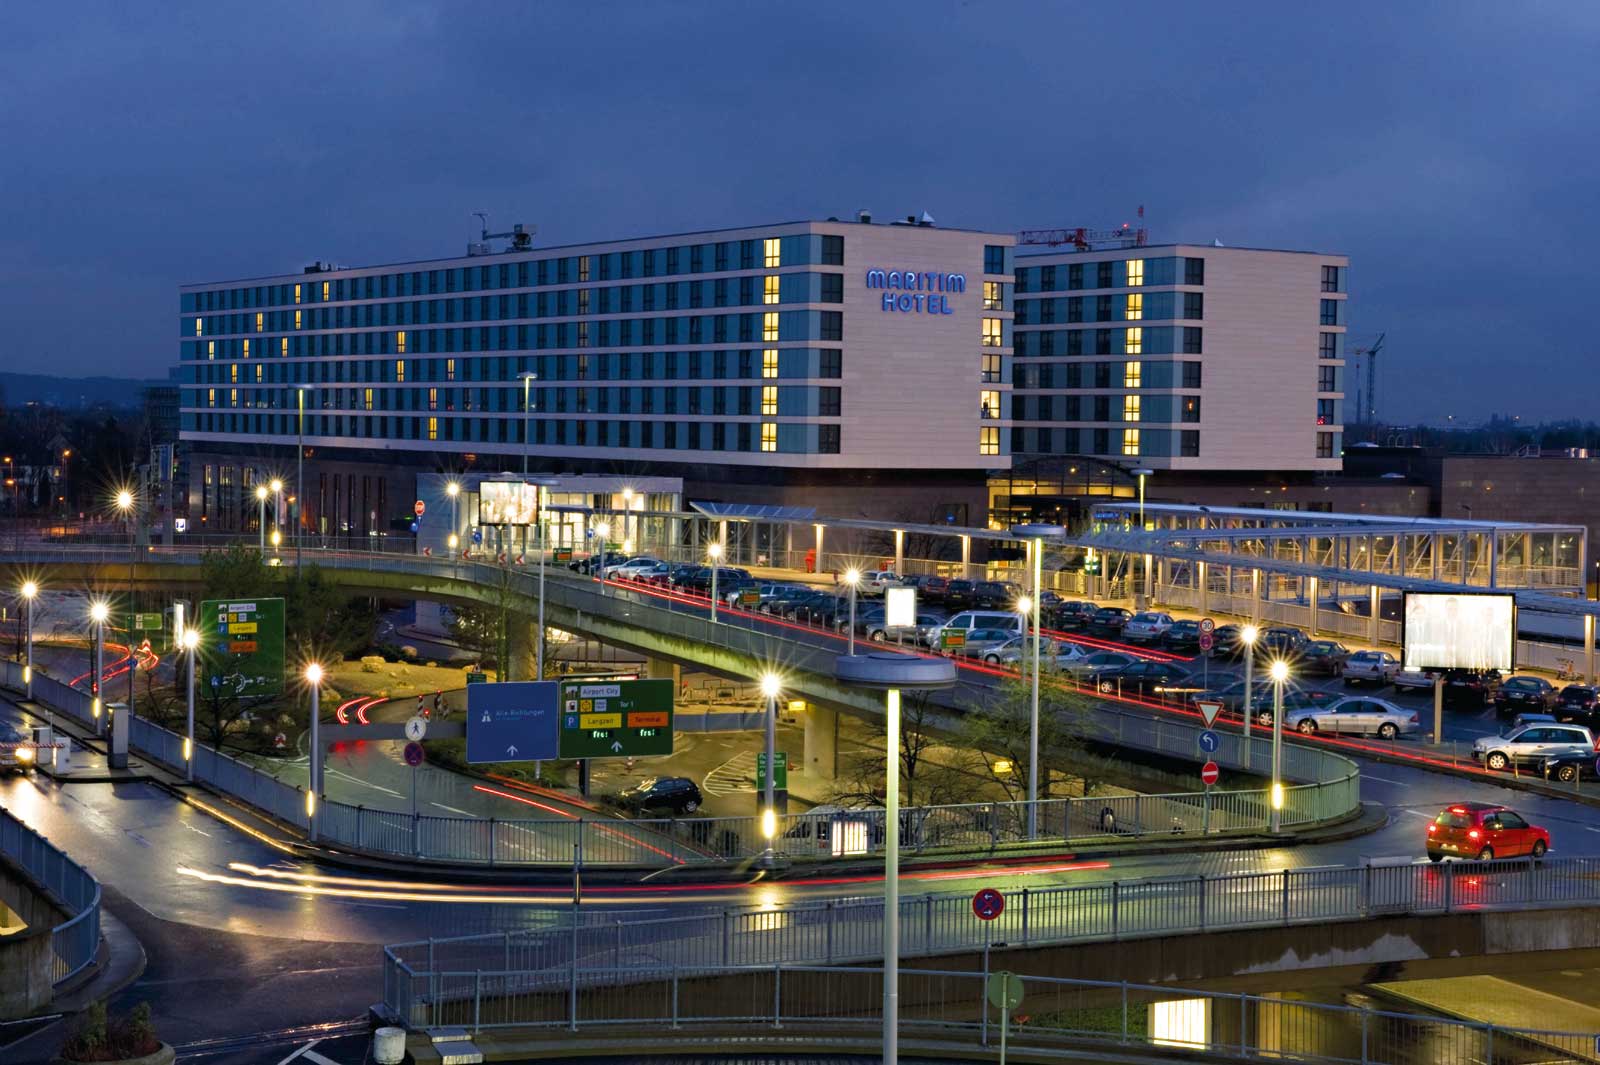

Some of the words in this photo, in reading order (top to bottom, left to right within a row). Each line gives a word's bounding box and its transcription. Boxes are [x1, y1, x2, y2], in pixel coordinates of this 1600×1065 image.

[866, 268, 966, 293] MARITIM
[881, 291, 954, 315] HOTEL
[582, 687, 605, 696] Airport
[606, 686, 619, 695] City
[567, 717, 575, 727] P
[588, 717, 614, 726] Langzeit
